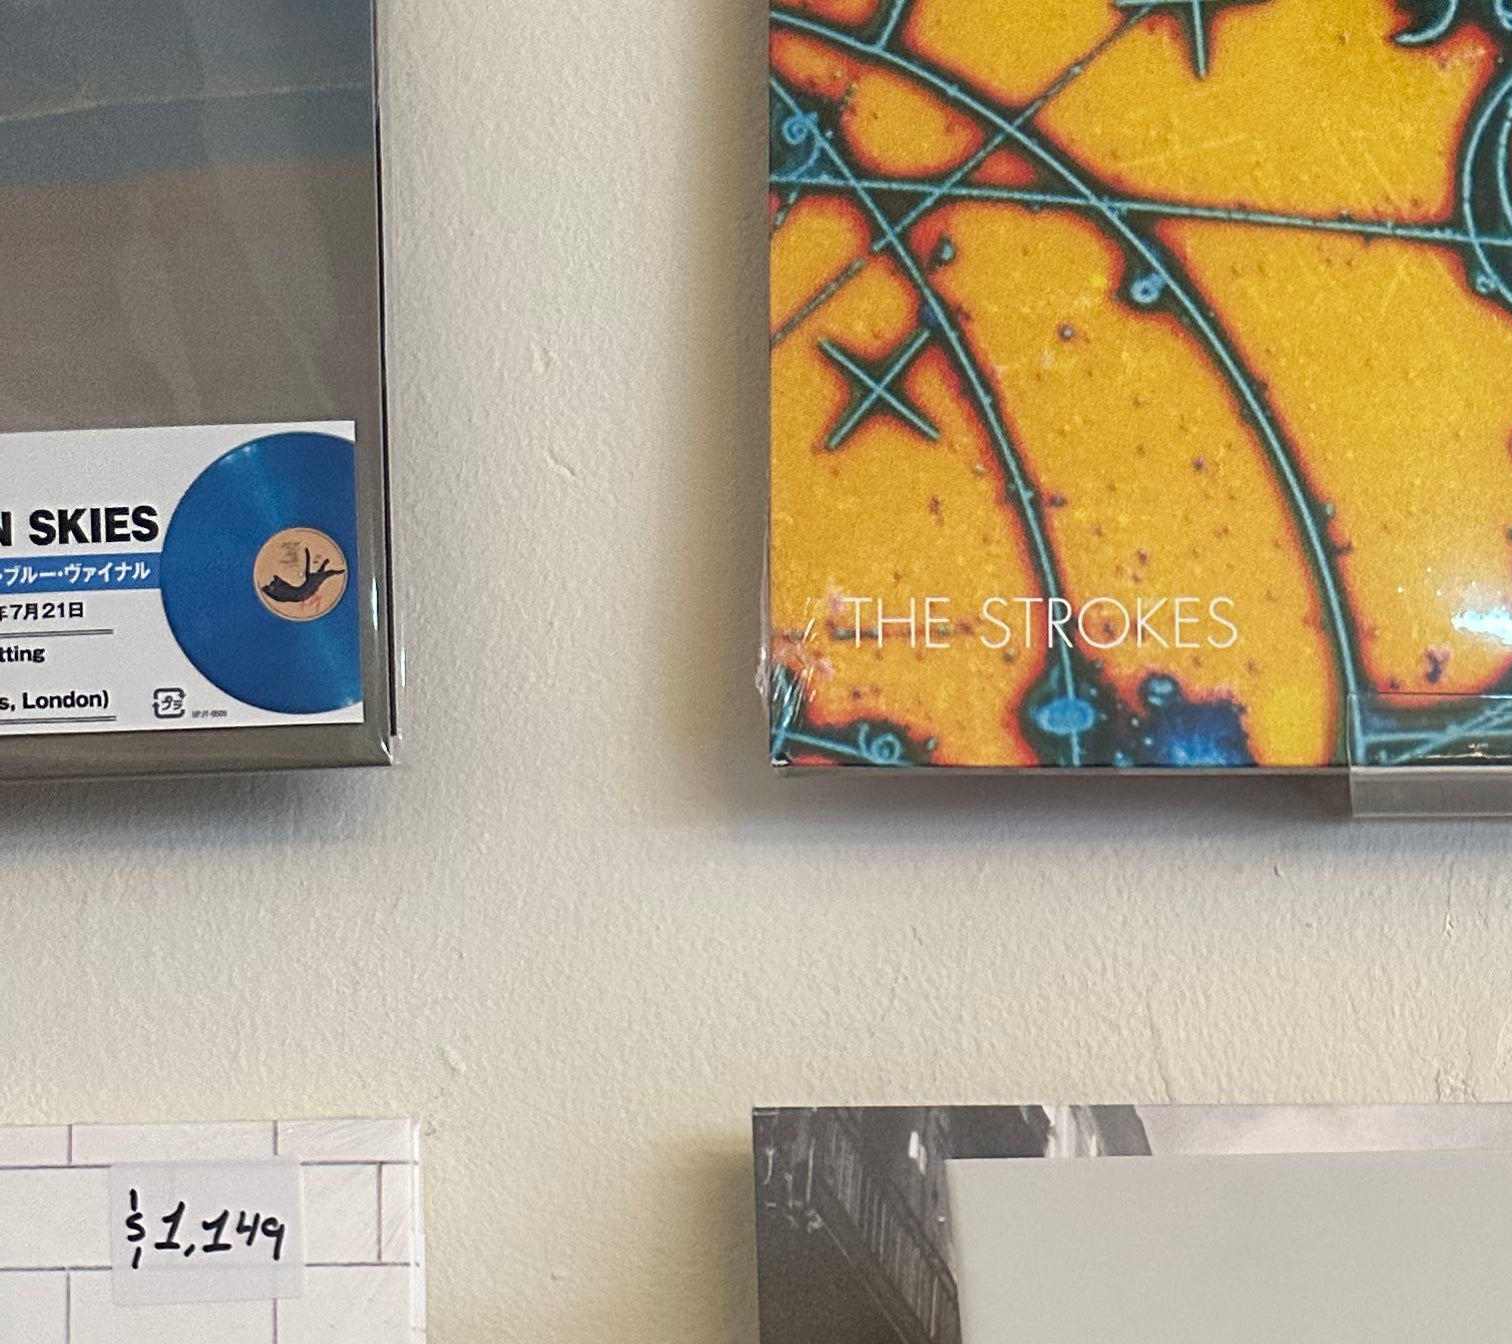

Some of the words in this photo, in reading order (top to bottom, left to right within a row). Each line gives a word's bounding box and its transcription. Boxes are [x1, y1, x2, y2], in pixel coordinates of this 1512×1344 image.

[29, 505, 159, 546] SKIES
[842, 597, 951, 649] THE
[980, 596, 1238, 649] STROKES
[22, 690, 109, 709] London)
[125, 1188, 286, 1270] $1,149
